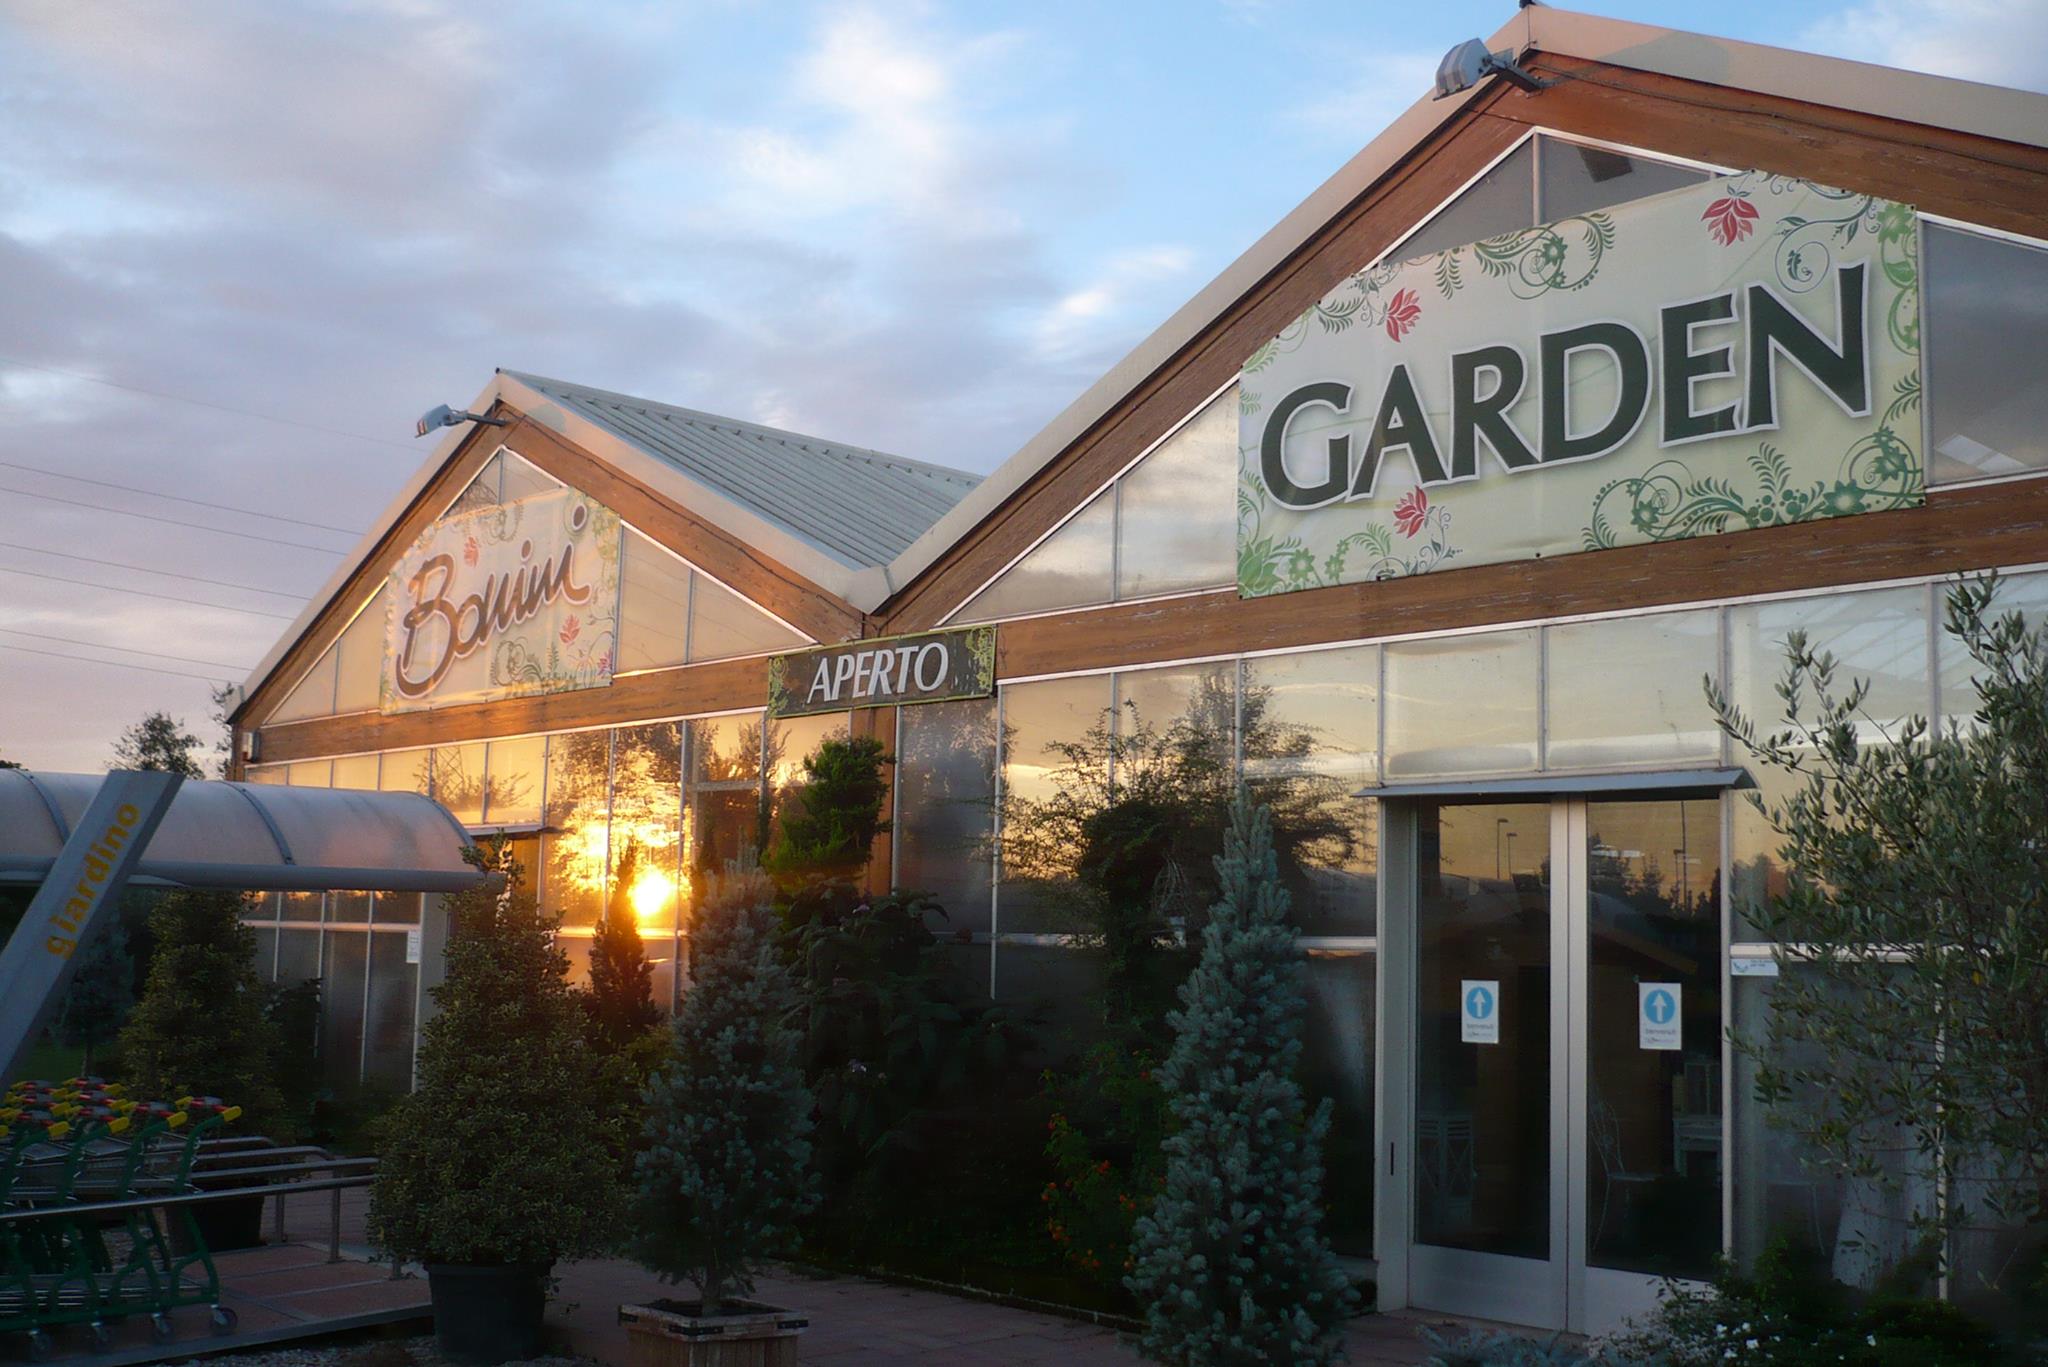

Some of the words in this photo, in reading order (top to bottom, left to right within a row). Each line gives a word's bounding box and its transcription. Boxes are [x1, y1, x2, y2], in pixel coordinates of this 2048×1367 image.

[1259, 257, 1872, 511] GARDEN
[807, 642, 949, 704] APERTO
[46, 803, 141, 960] giardino
